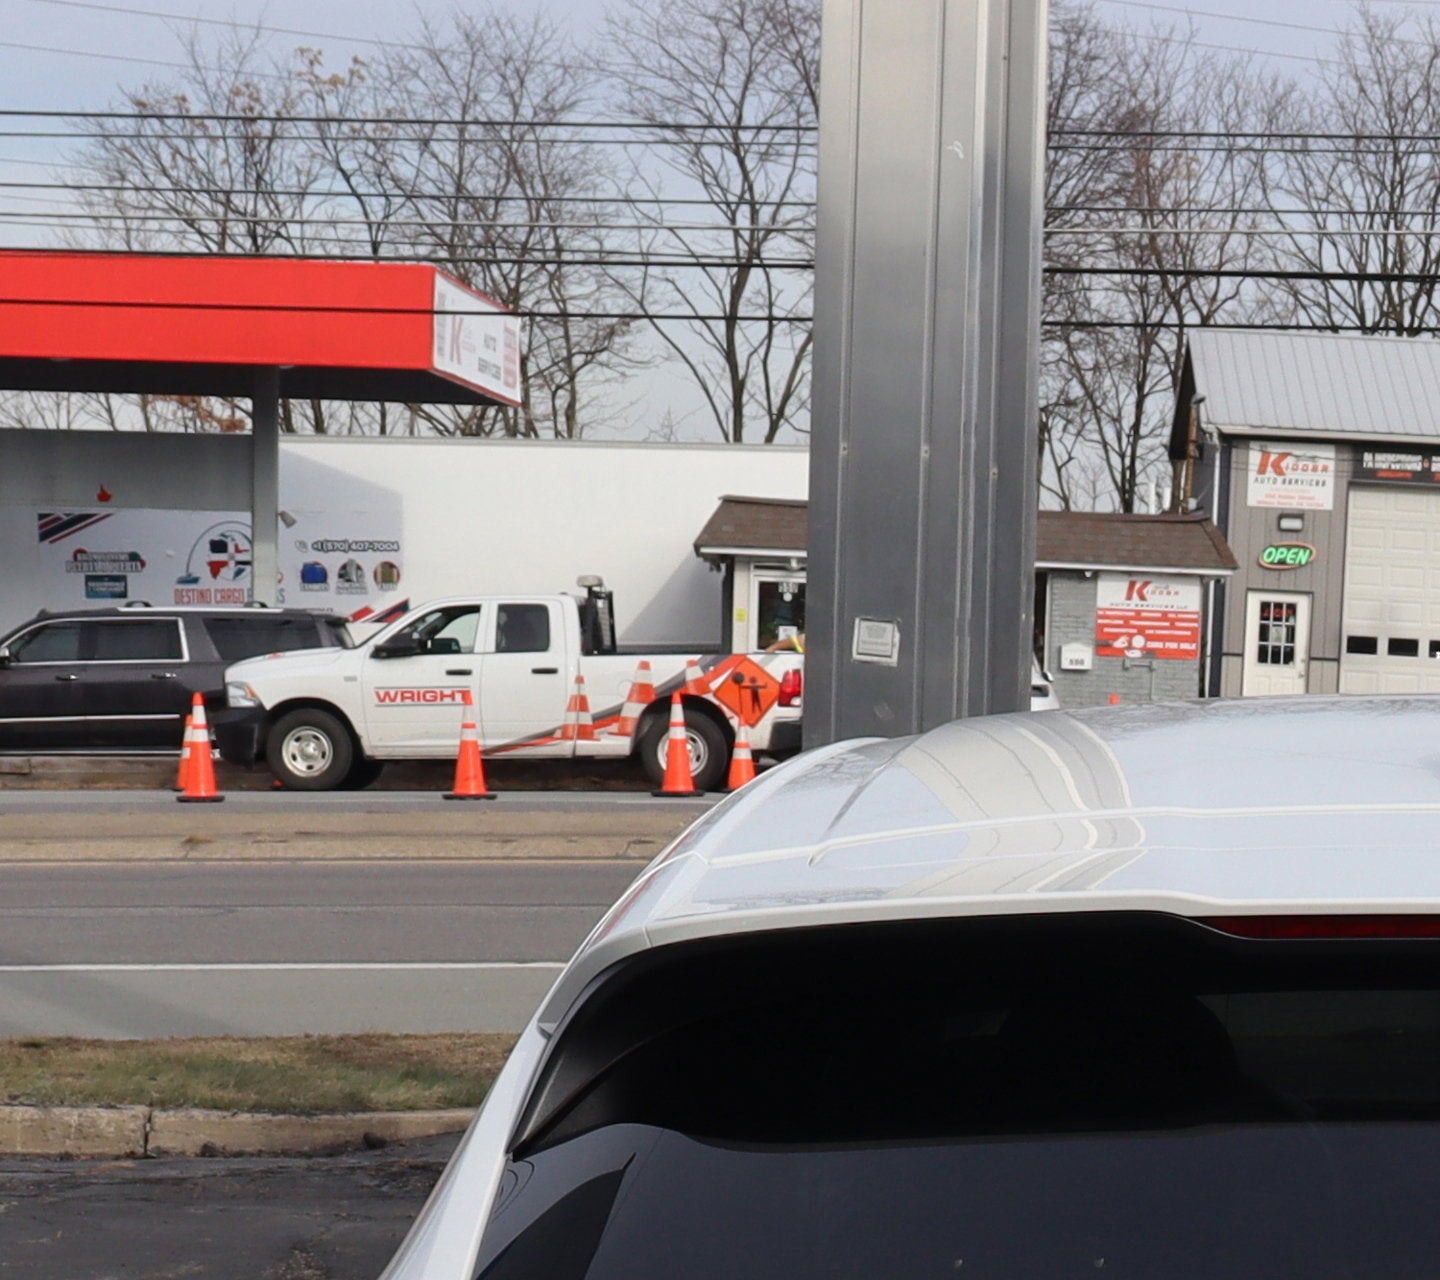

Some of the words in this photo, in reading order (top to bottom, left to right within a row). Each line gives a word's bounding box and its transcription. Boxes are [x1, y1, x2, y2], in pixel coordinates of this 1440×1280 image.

[1254, 476, 1278, 485] AUTO
[1263, 546, 1311, 565] OPEN
[173, 587, 211, 605] DESTINO
[214, 588, 245, 605] CARGO
